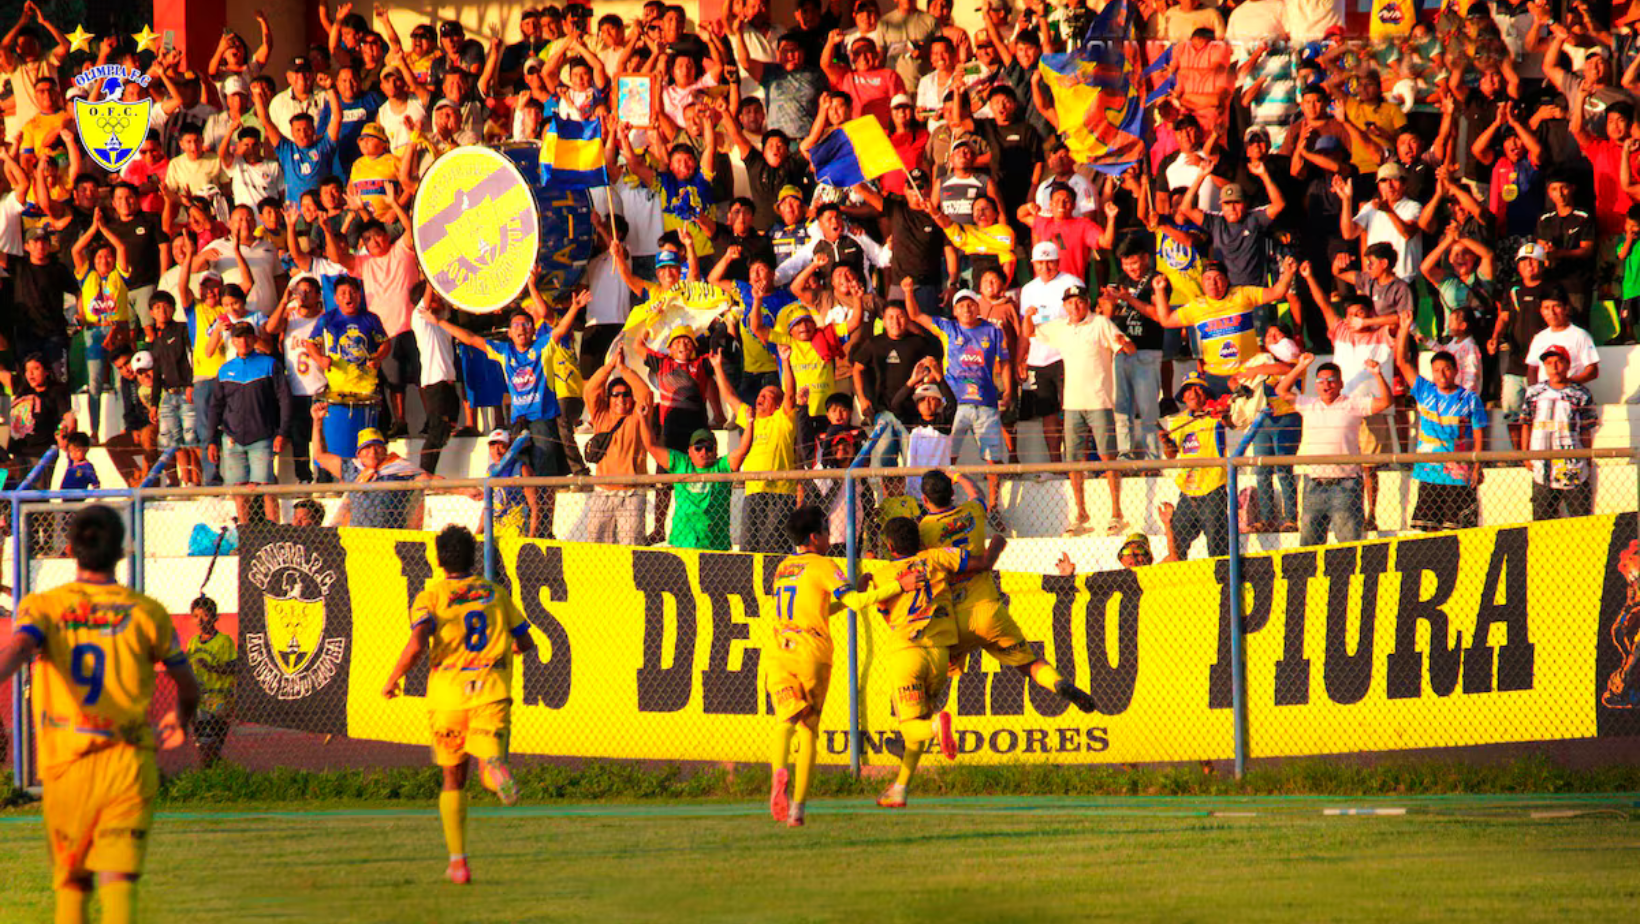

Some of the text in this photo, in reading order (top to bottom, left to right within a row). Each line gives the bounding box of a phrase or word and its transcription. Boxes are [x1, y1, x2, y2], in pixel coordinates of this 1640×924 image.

[298, 351, 309, 375] 6
[960, 353, 983, 363] AVA
[774, 585, 797, 621] 17
[1208, 526, 1535, 709] PIURA
[464, 610, 487, 652] 8
[71, 643, 106, 706] 9
